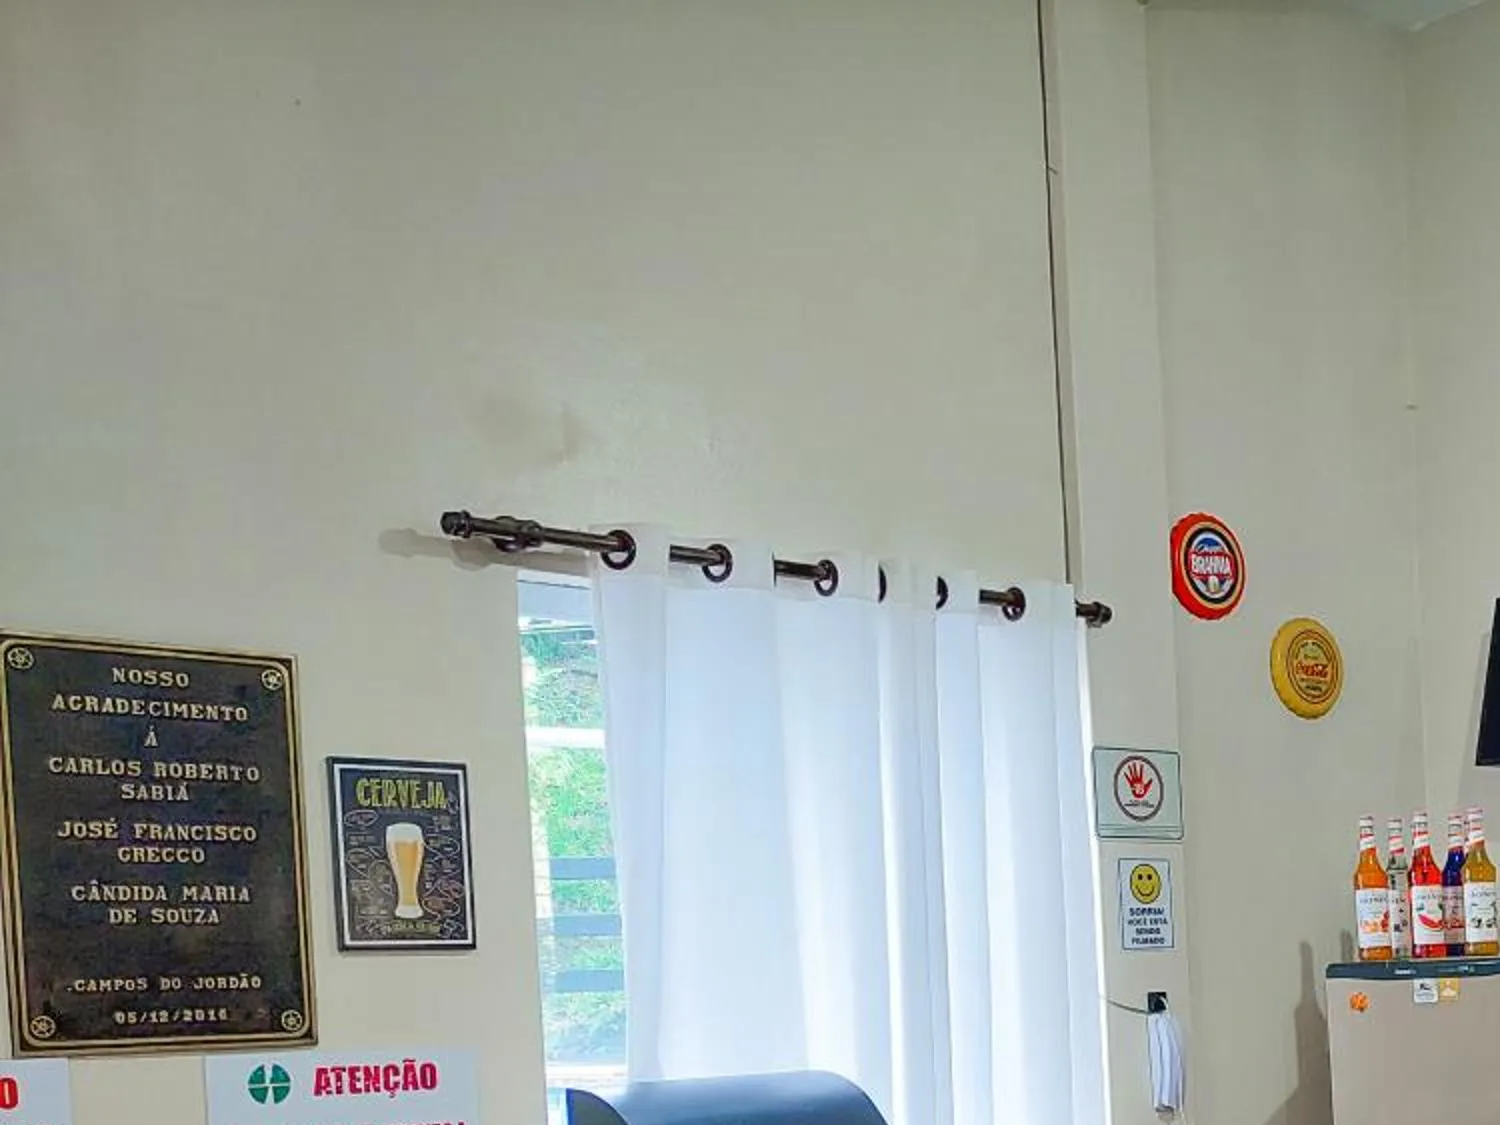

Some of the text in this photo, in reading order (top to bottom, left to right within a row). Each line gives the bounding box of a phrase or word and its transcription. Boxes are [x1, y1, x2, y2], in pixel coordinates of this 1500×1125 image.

[112, 667, 190, 687] NOSSO
[52, 694, 248, 721] AGRADECIMENTO
[49, 757, 260, 781] CARLOS ROBERTO
[121, 782, 190, 801] SABIÁ
[356, 778, 448, 809] CERVEJA
[57, 818, 257, 842] JOSÉ FRANCISCO
[118, 847, 206, 863] GRECCO
[71, 879, 250, 901] CÂNDIDA MARIA
[109, 908, 220, 924] DE SOUZA
[160, 977, 182, 990] DO
[193, 973, 262, 990] JORDÃO
[313, 1058, 437, 1098] ATENÇÃO
